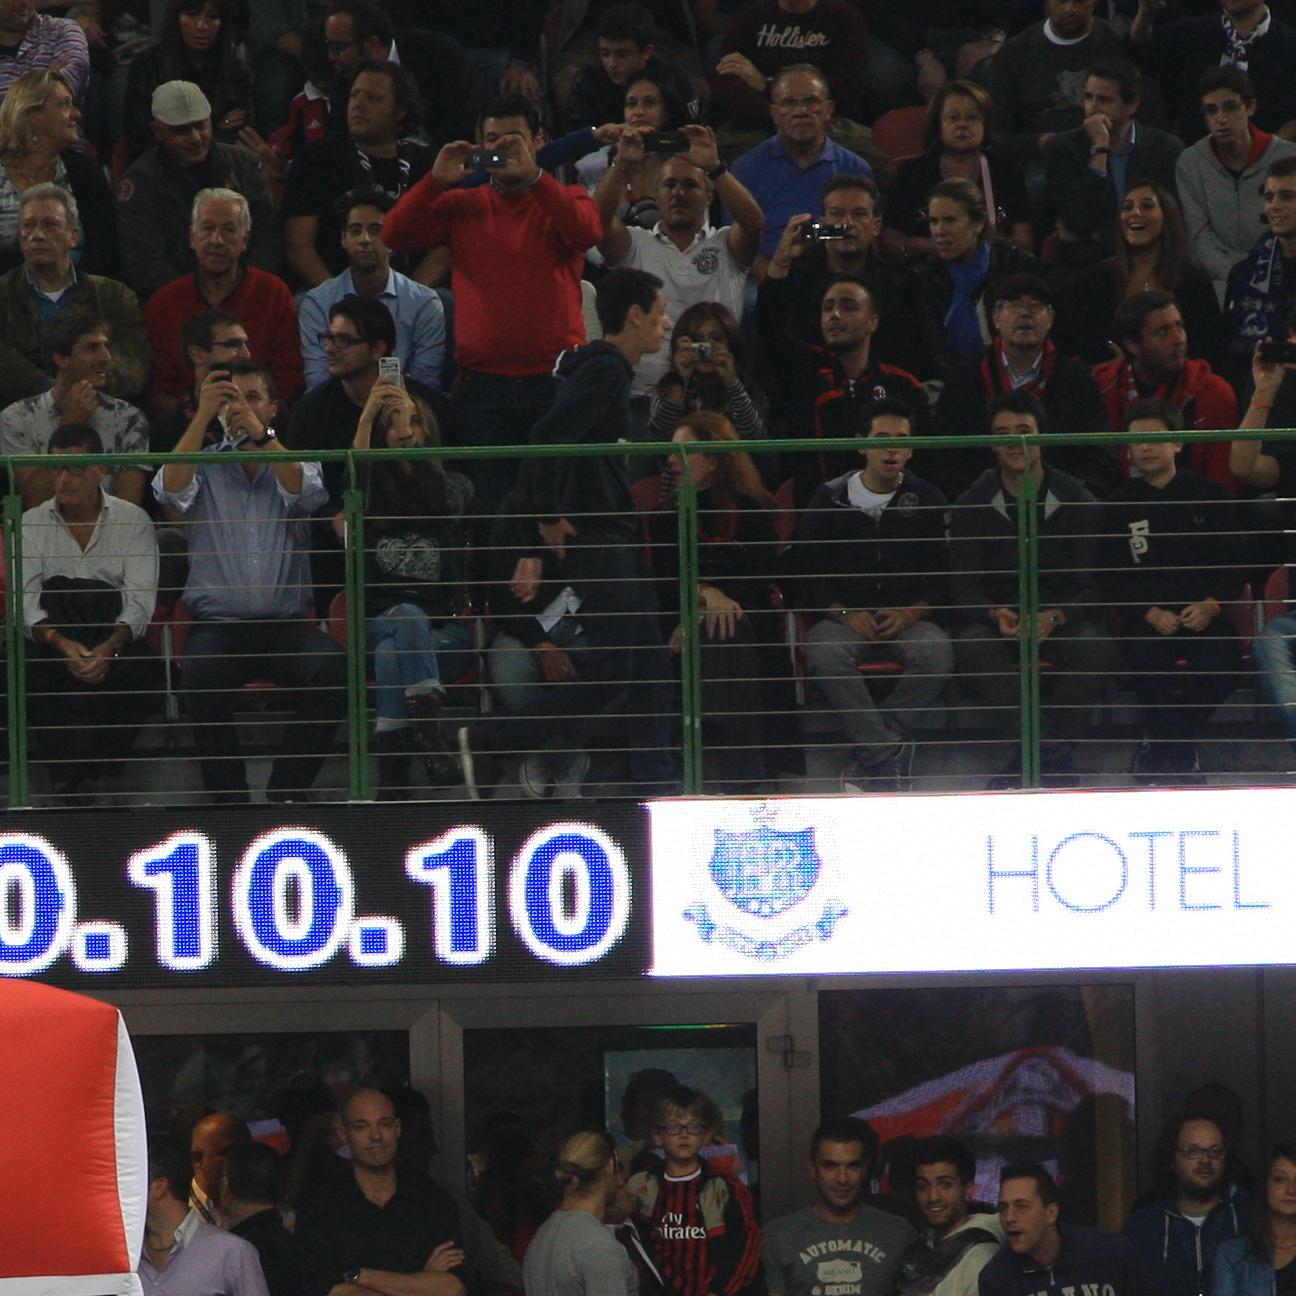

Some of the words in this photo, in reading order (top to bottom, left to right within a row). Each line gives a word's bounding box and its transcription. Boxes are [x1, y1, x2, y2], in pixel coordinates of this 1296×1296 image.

[988, 829, 1272, 915] HOTEL
[656, 1223, 707, 1240] irates
[799, 1239, 886, 1265] AUTOMATIC
